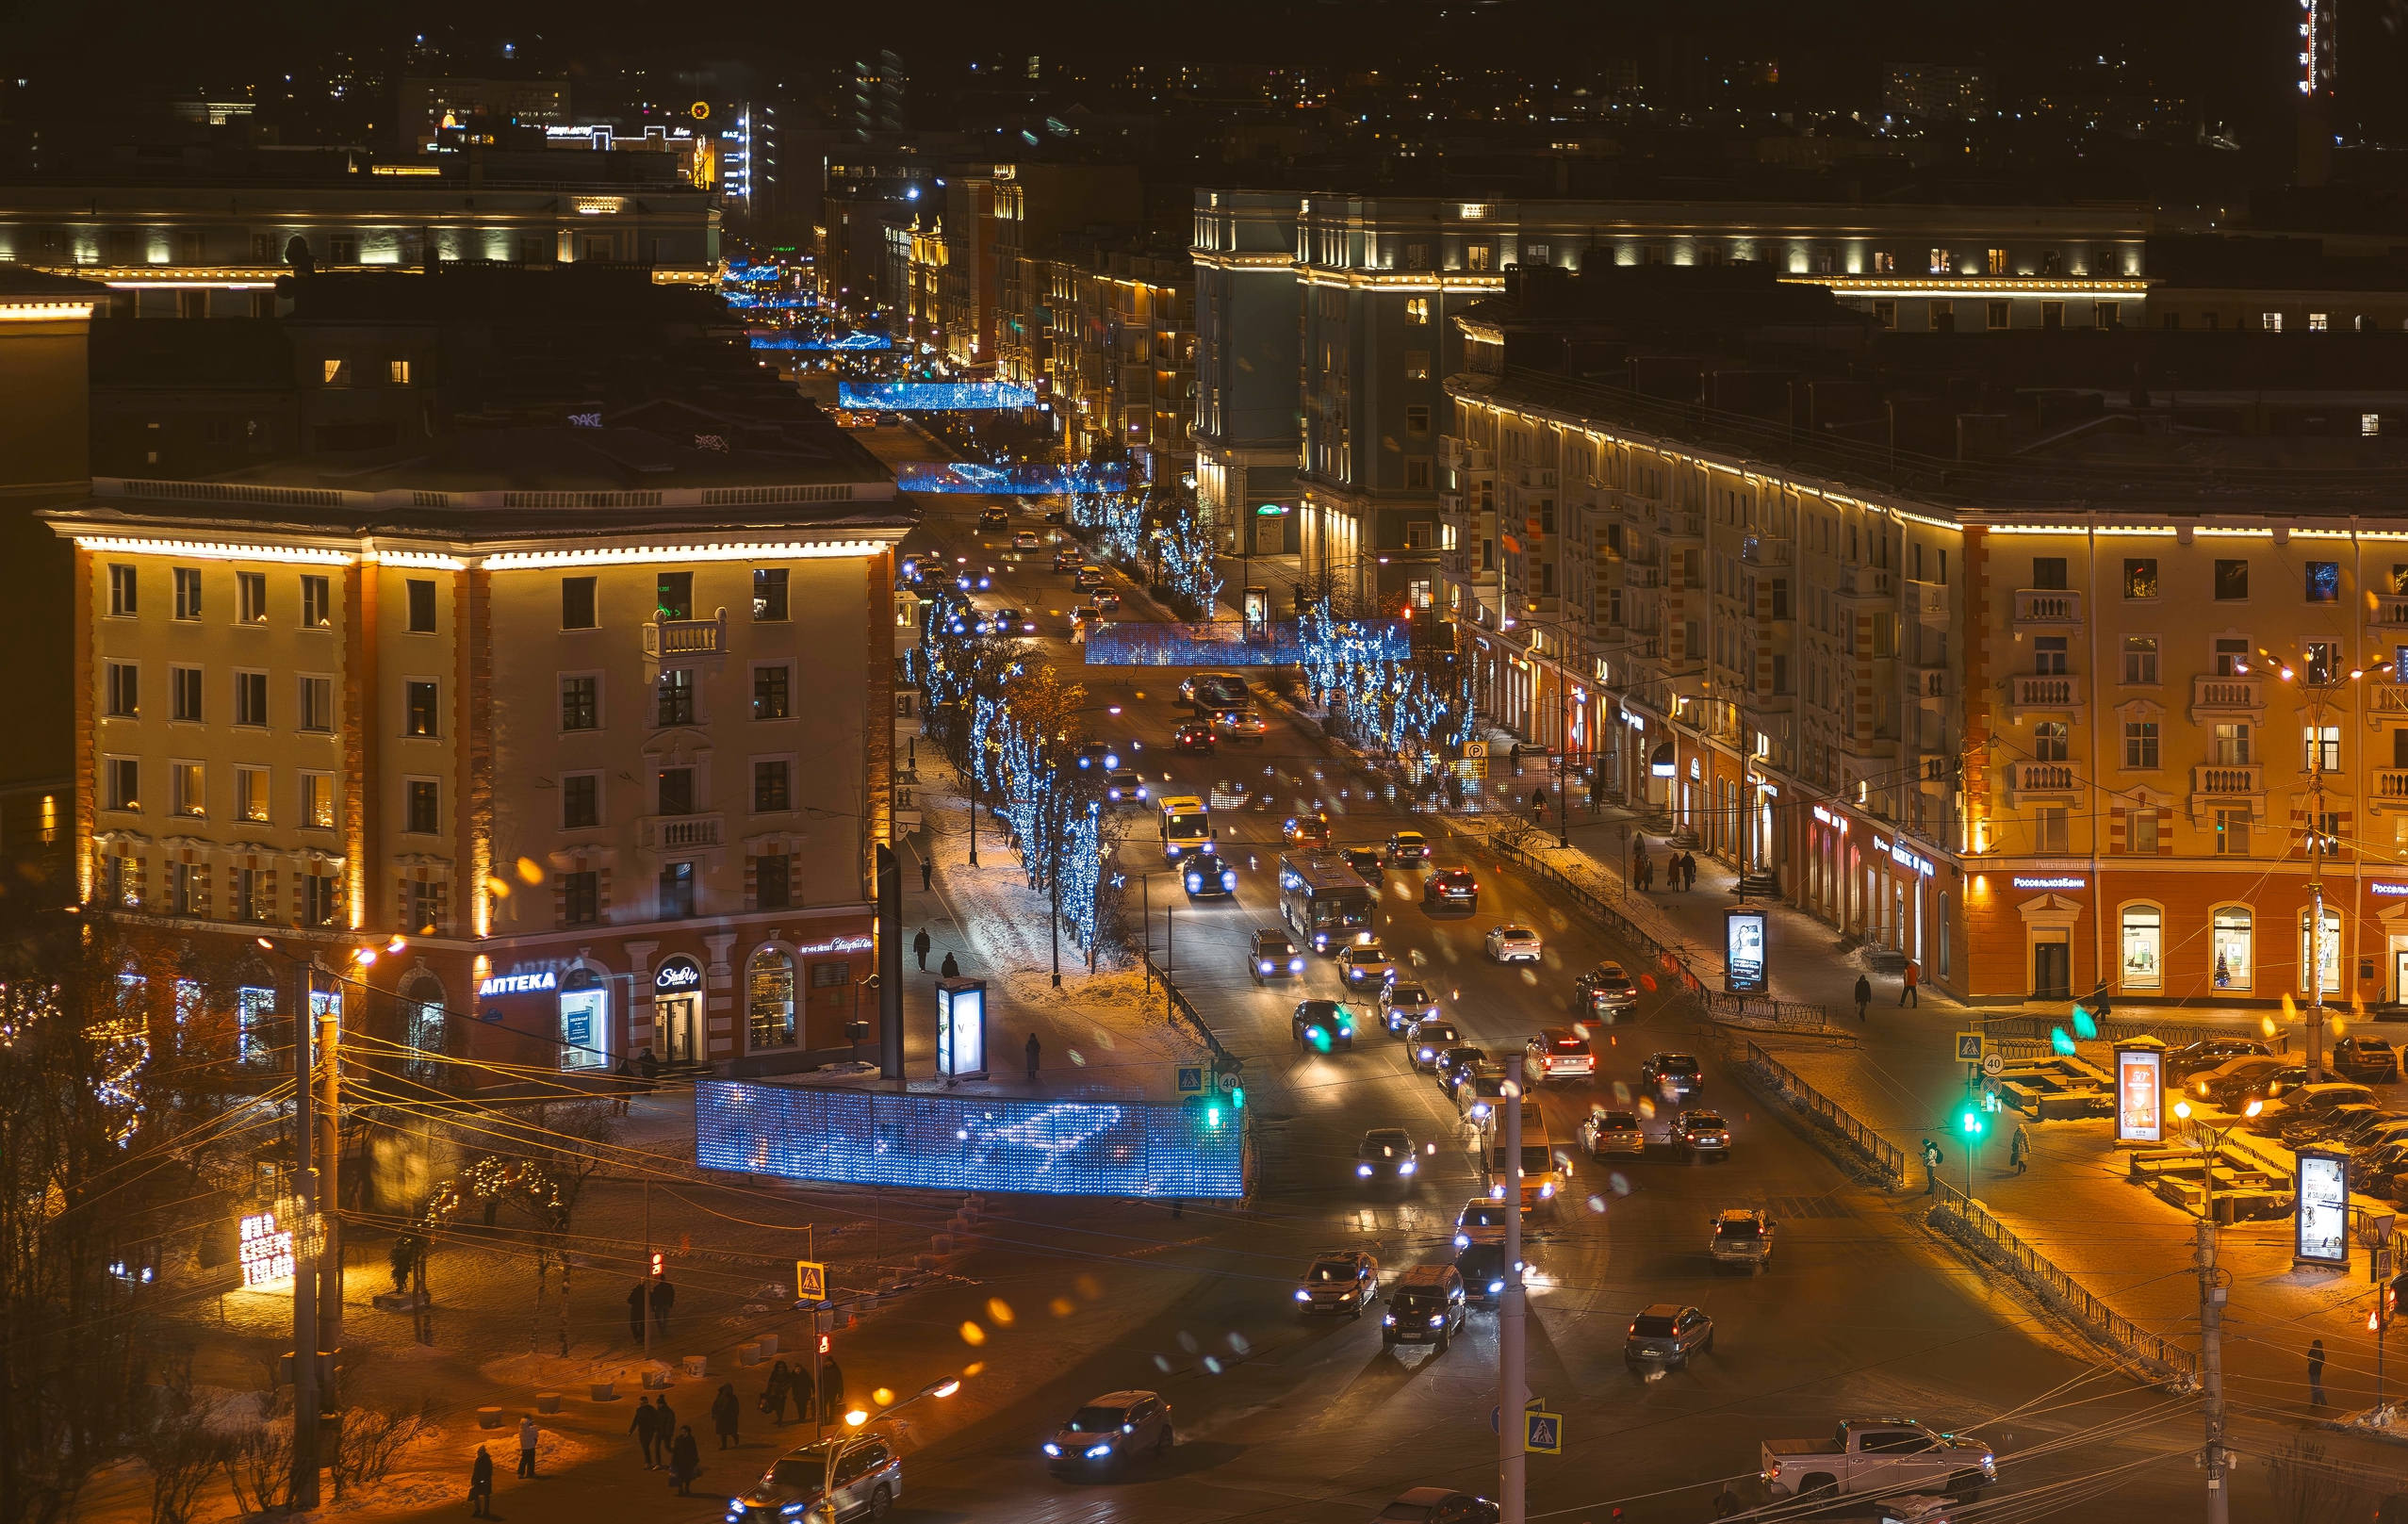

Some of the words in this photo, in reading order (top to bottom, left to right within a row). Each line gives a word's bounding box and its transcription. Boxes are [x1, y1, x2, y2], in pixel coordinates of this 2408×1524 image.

[479, 972, 557, 996] АПТЕКА
[1987, 1058, 2001, 1069] 40
[1222, 1078, 1237, 1088] 40
